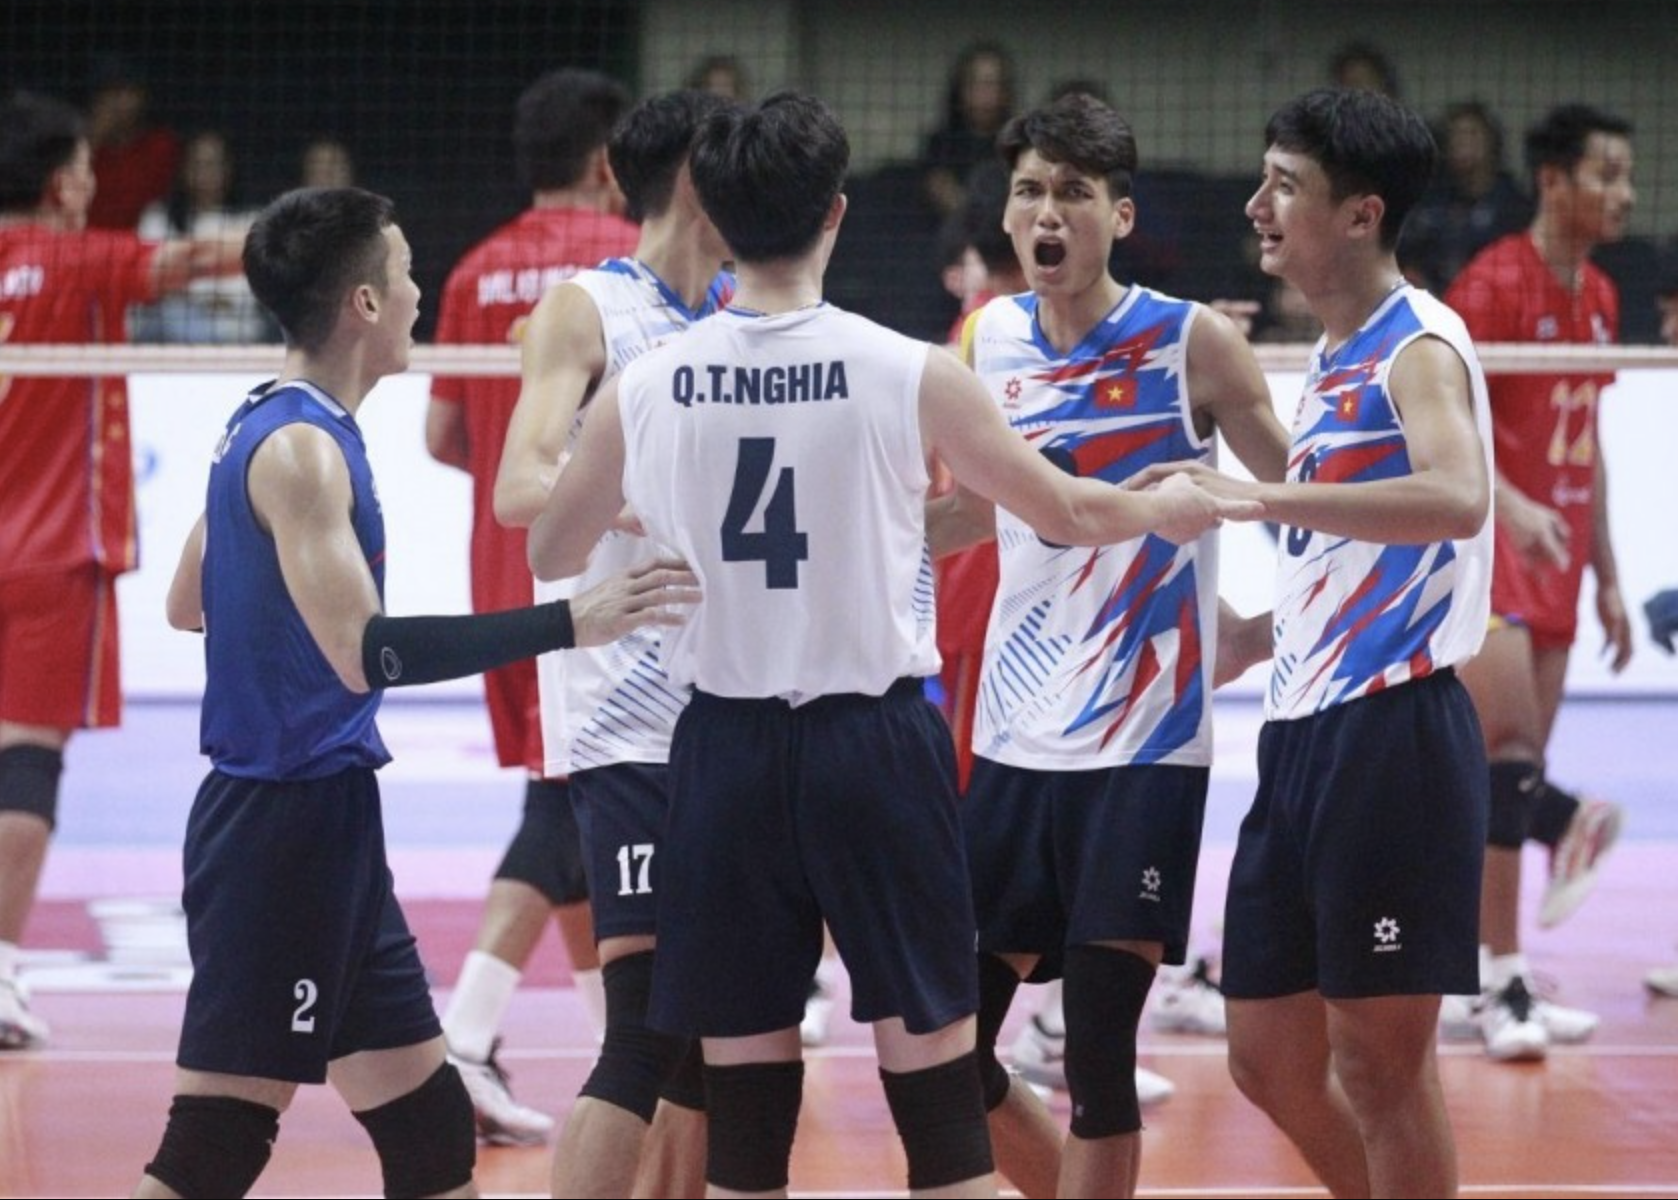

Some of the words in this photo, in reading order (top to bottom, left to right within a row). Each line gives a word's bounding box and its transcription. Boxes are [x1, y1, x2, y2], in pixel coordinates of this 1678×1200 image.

[672, 360, 849, 407] Q.T.NGHIA
[720, 436, 809, 589] 4
[616, 843, 655, 896] 17
[291, 978, 318, 1033] 2
